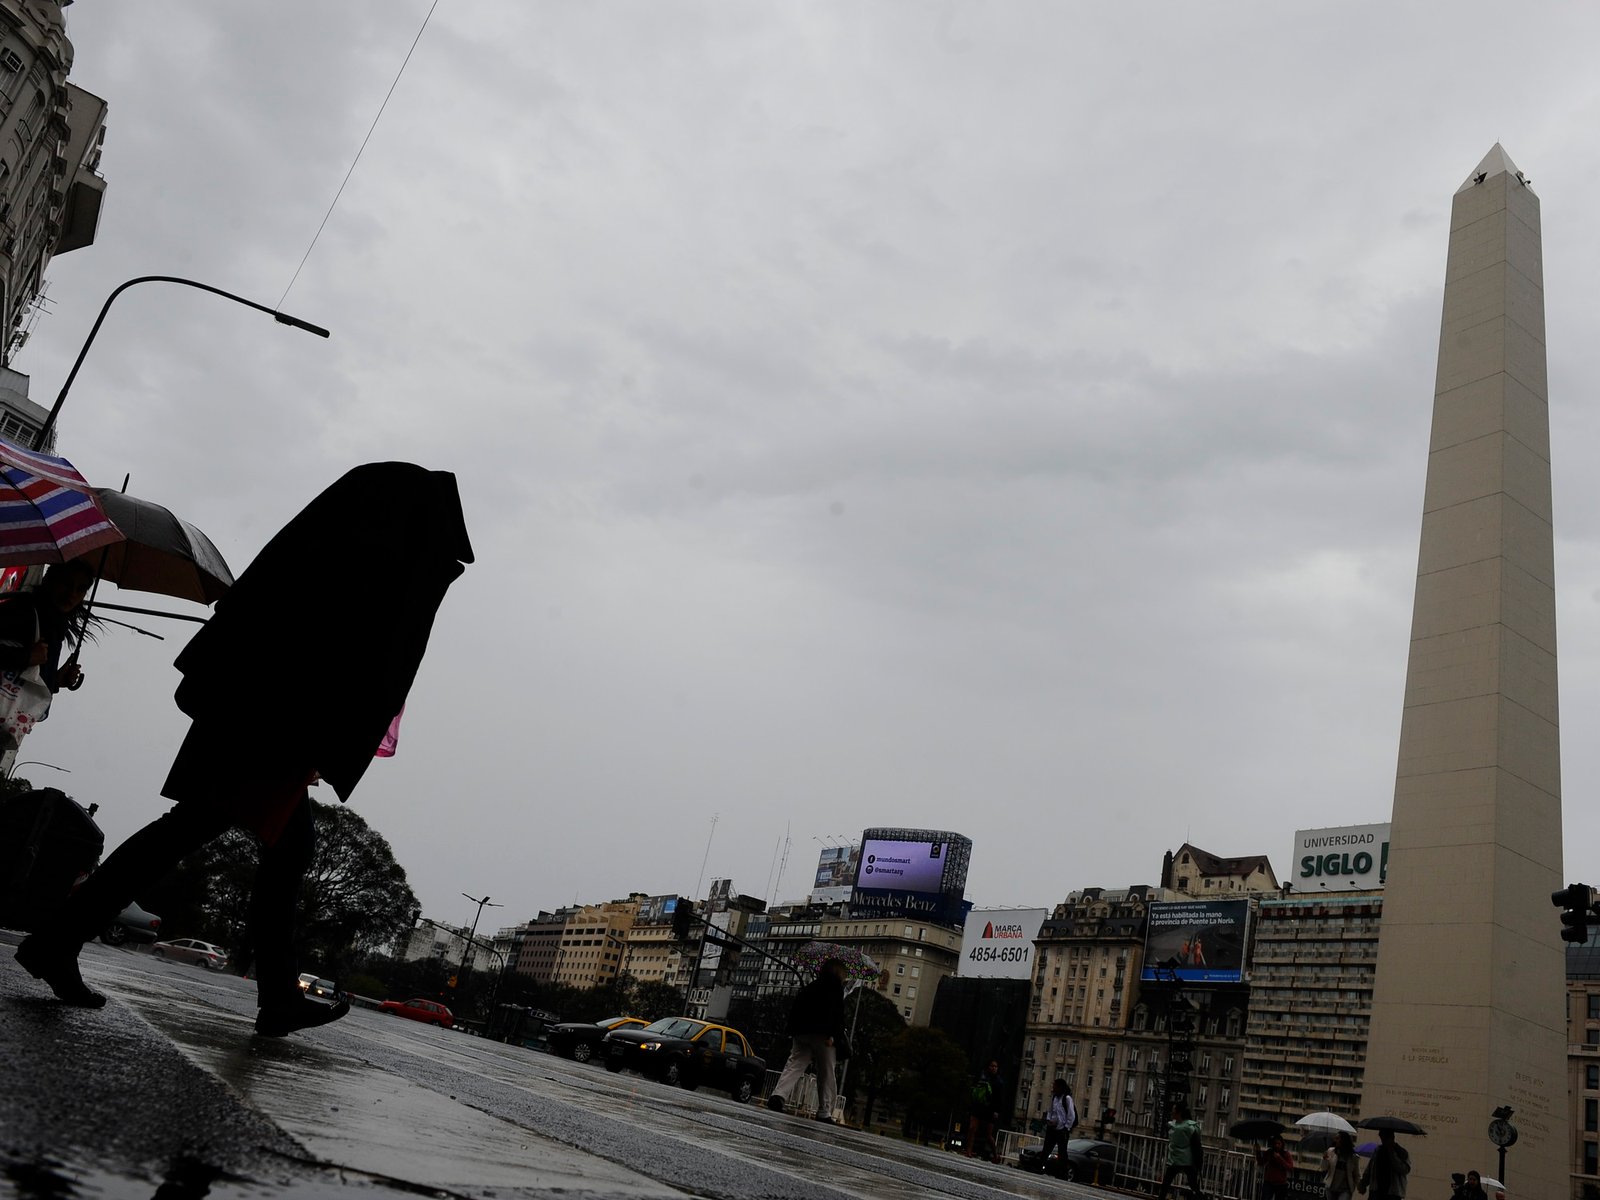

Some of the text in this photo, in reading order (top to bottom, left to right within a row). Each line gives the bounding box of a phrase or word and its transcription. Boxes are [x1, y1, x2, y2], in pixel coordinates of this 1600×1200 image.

[1304, 833, 1375, 848] UNIVERSIDAD
[1300, 851, 1373, 878] SIGLO
[874, 866, 904, 876] @smartarg
[852, 891, 937, 912] Mercedes Benz
[1172, 911, 1199, 919] habilitada
[995, 924, 1022, 932] MARCA
[994, 931, 1023, 939] URBANA
[969, 947, 1029, 962] 4854-6501
